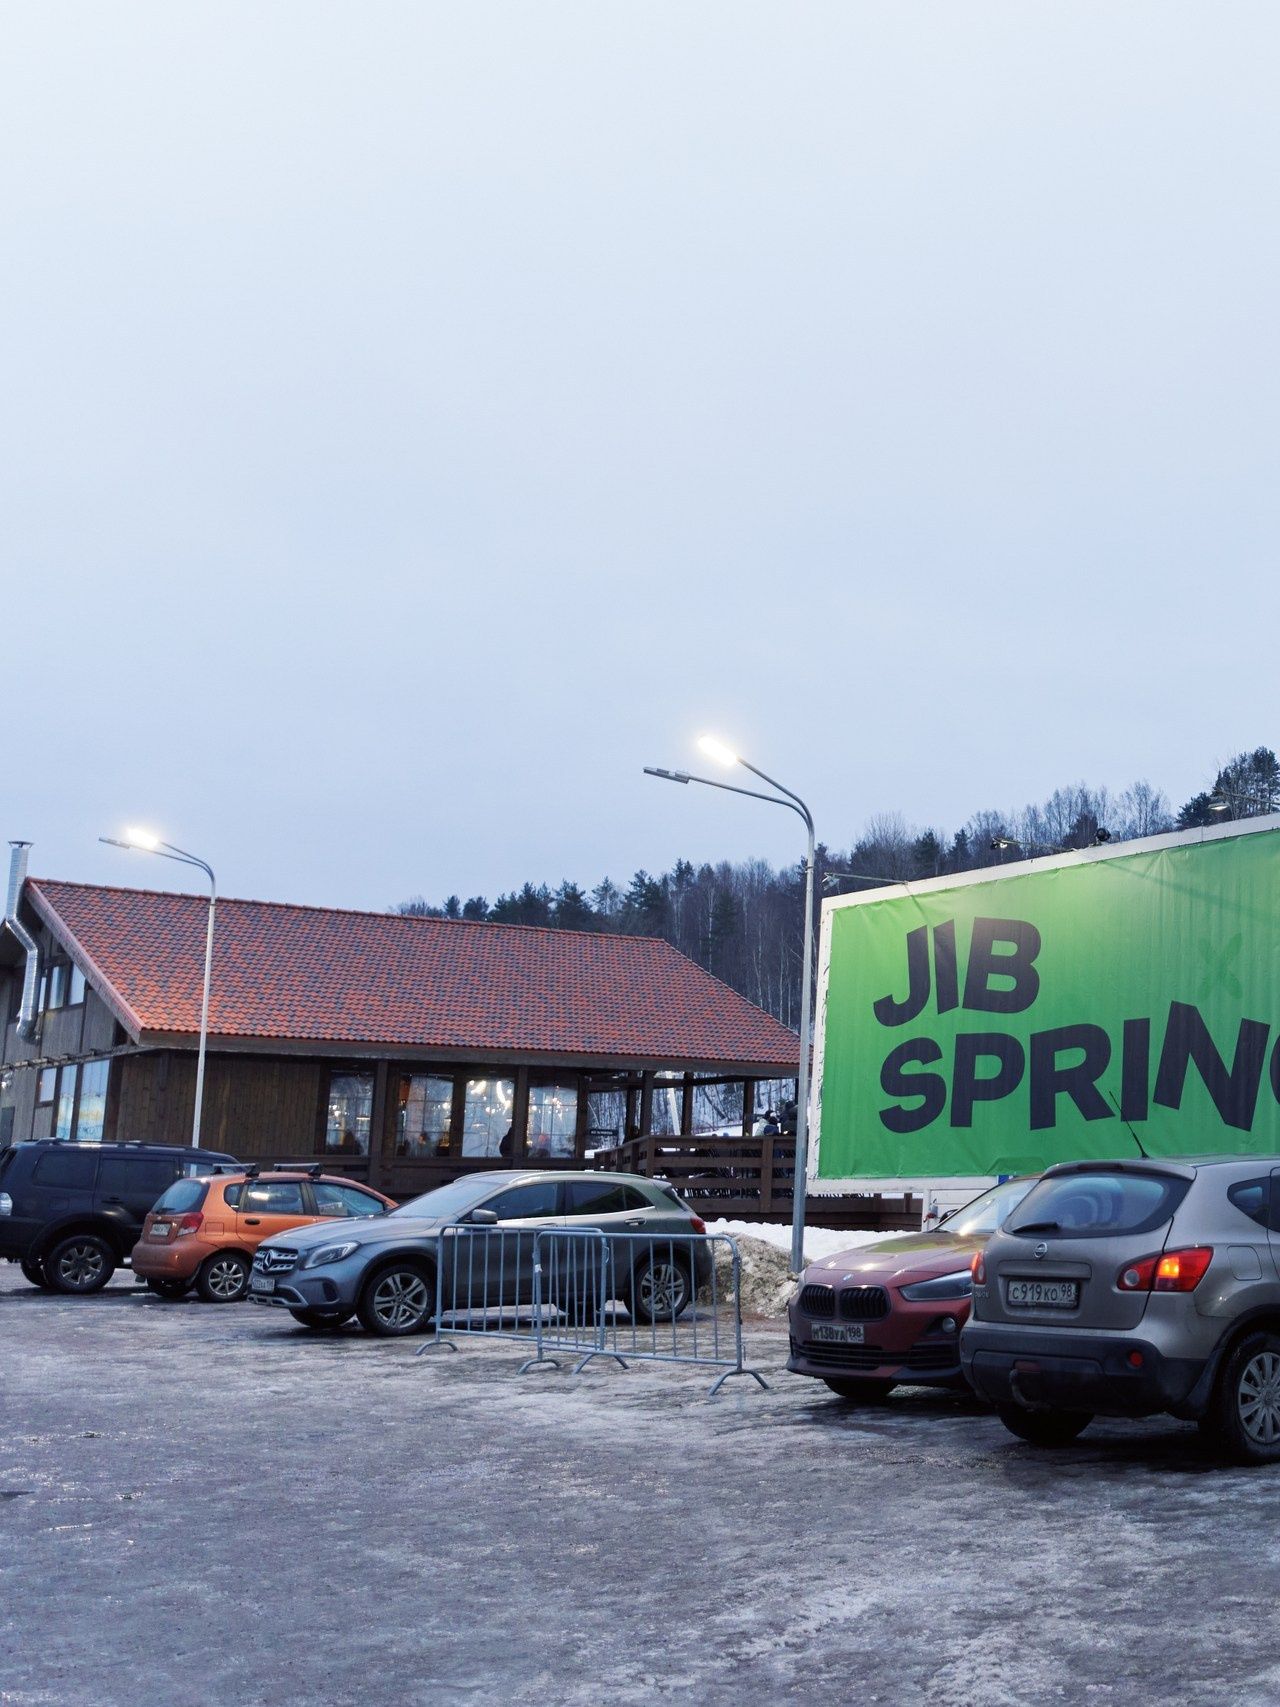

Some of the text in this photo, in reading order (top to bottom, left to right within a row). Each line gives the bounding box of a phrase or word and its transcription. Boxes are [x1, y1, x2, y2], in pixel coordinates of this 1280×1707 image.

[873, 916, 1042, 1027] JIB
[1012, 1283, 1072, 1301] С919КО 98
